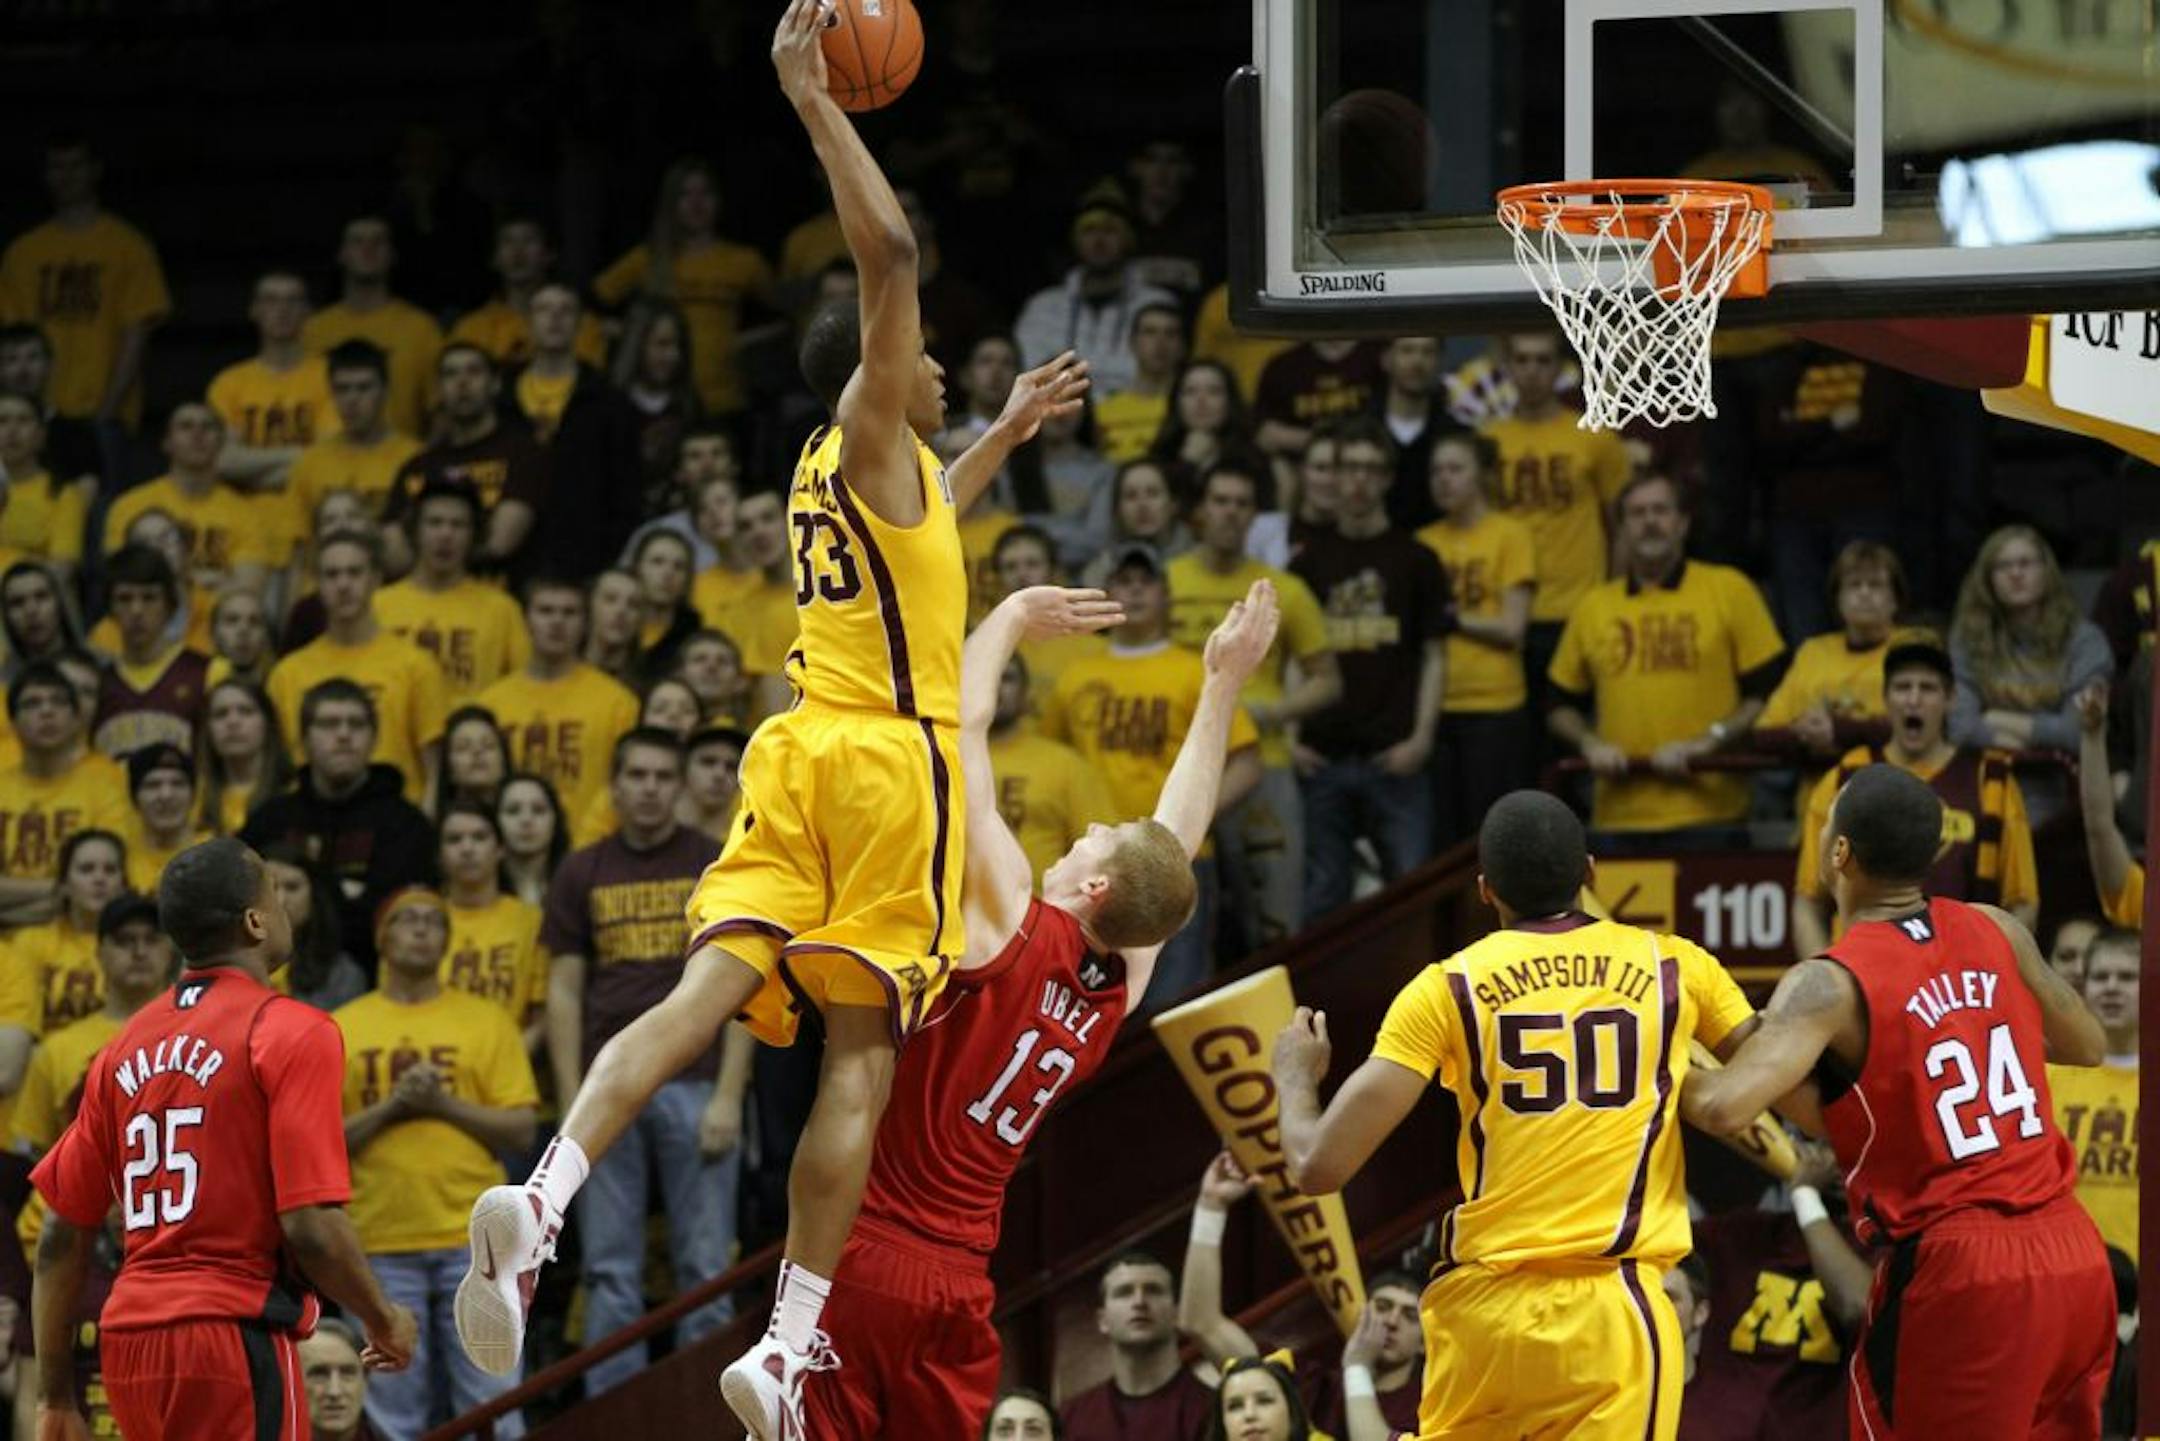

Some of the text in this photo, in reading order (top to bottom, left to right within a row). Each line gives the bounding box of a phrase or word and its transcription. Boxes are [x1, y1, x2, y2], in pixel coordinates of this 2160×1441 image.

[1300, 272, 1385, 296] SPALDING
[793, 512, 863, 606] 33
[1694, 881, 1786, 948] 110
[1040, 980, 1101, 1045] UBEL
[1476, 955, 1655, 1013] SAMPSON III
[1906, 970, 1998, 1030] TALLEY
[115, 1035, 223, 1098] WALKER
[966, 1028, 1076, 1146] 13
[1498, 1007, 1639, 1113] 50
[1924, 1023, 2044, 1161] 24
[123, 1106, 204, 1232] 25
[1190, 1025, 1355, 1313] GOPHERS
[1729, 1271, 1840, 1364] M
